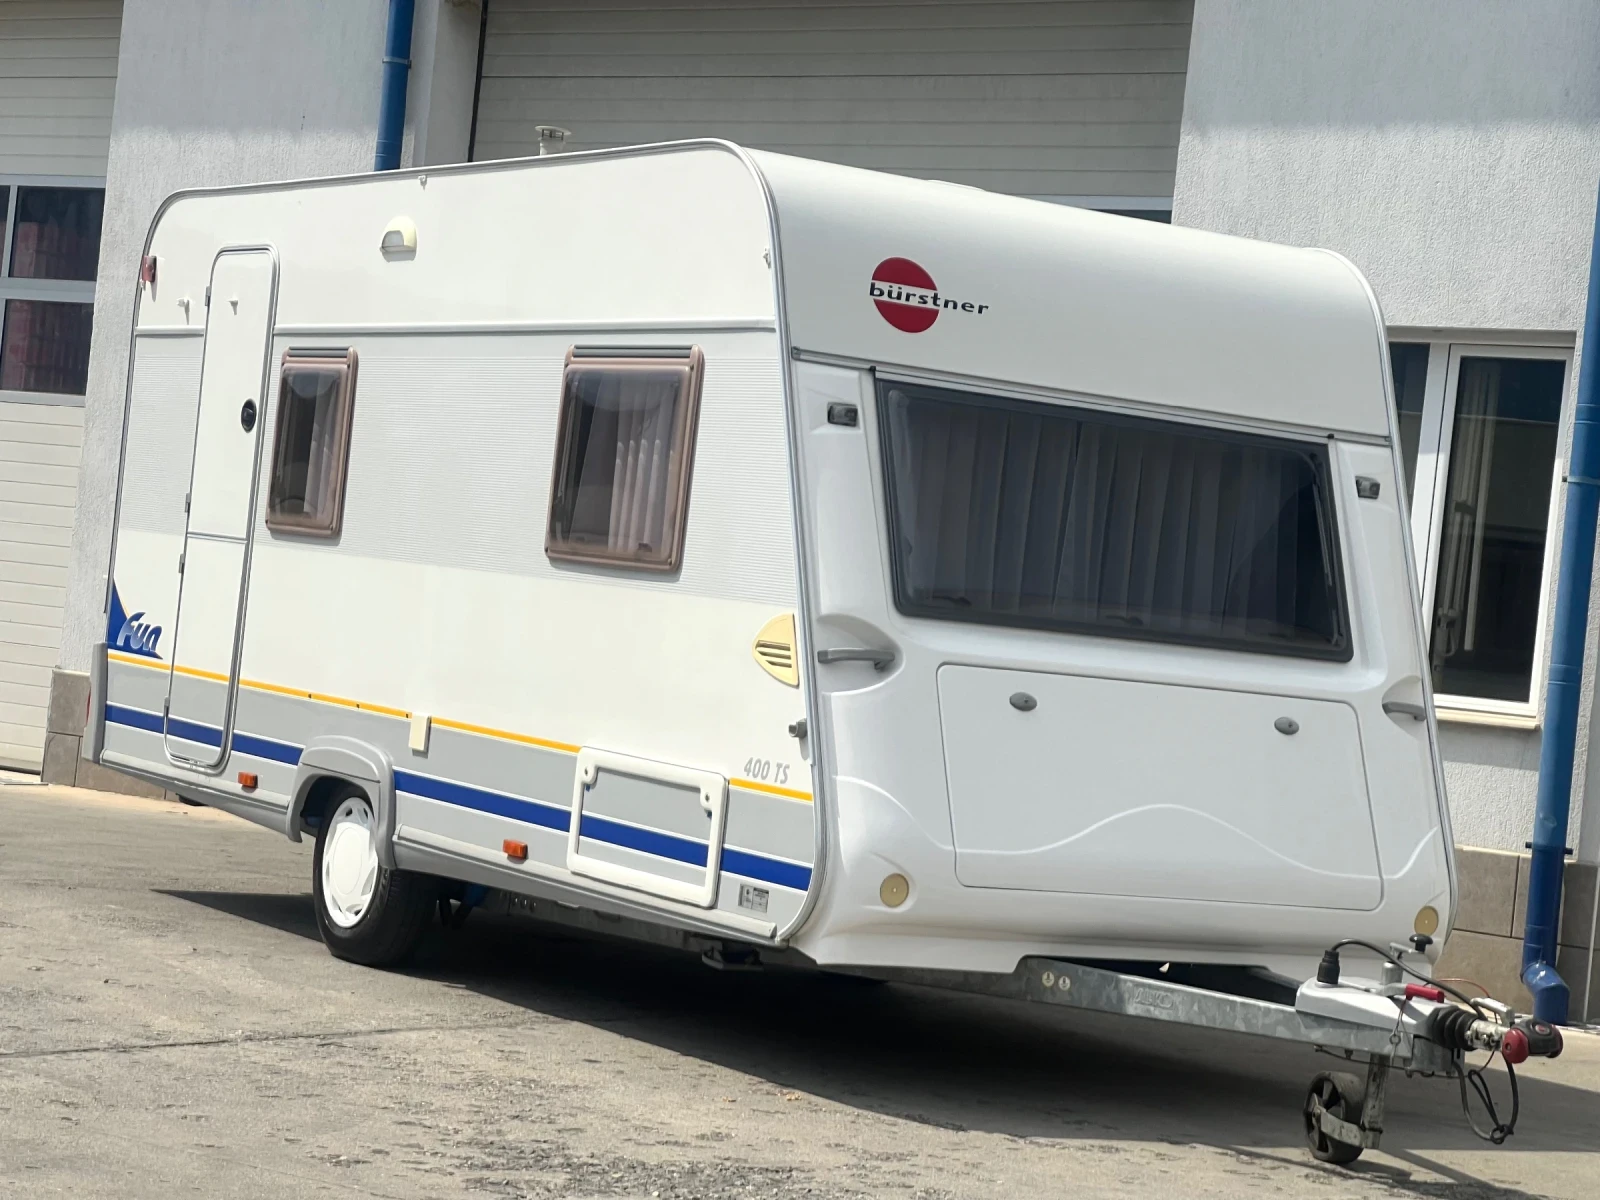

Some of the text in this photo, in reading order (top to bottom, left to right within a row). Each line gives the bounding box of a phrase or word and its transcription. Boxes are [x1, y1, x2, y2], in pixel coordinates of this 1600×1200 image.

[869, 282, 989, 314] bürstner
[116, 611, 162, 652] Fun
[743, 757, 790, 784] 400 TS
